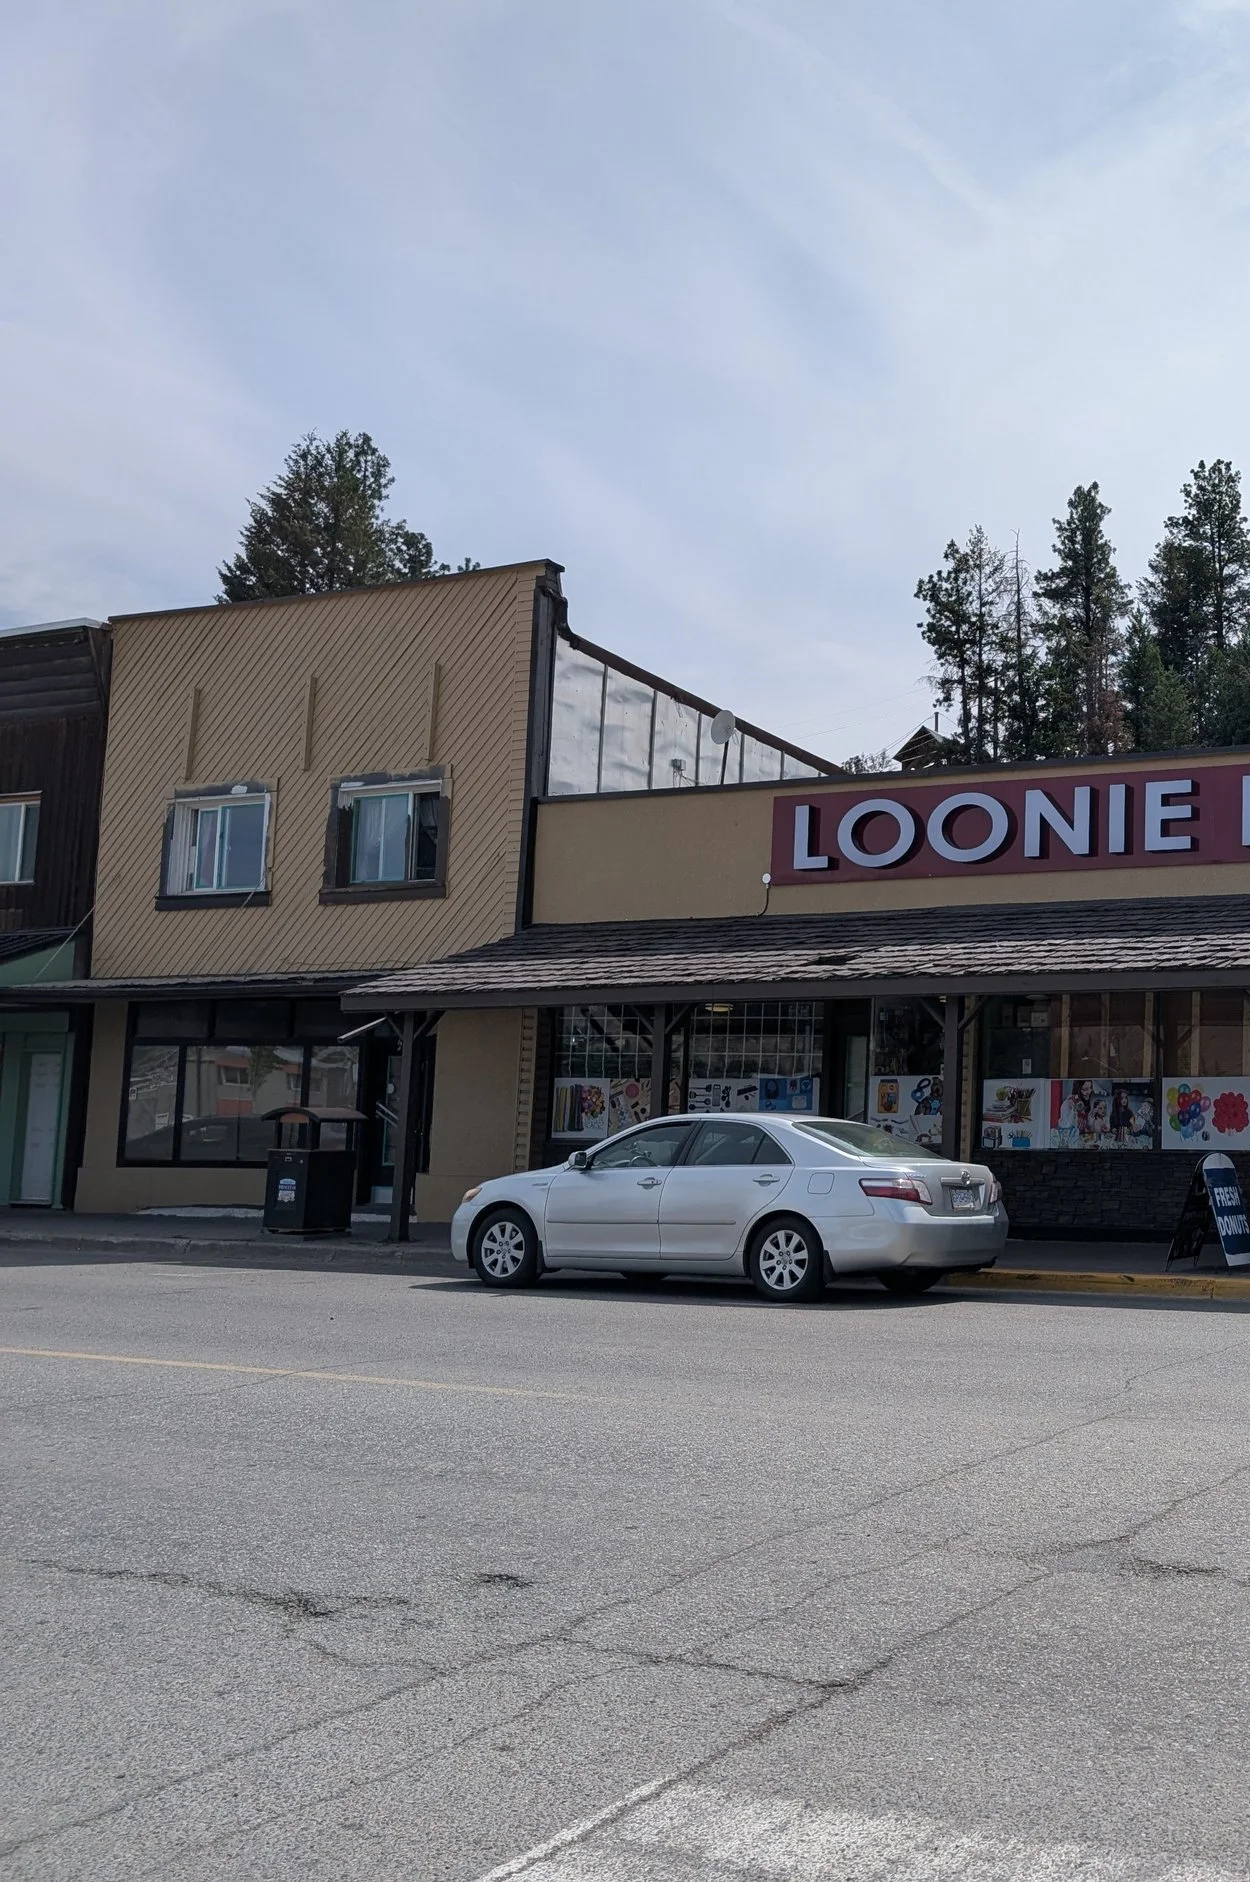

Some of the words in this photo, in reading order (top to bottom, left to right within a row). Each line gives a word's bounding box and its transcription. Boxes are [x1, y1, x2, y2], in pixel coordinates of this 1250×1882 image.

[793, 779, 1194, 870] LOONIE
[1213, 1186, 1241, 1207] FRESH
[1217, 1214, 1250, 1236] DONUTS
